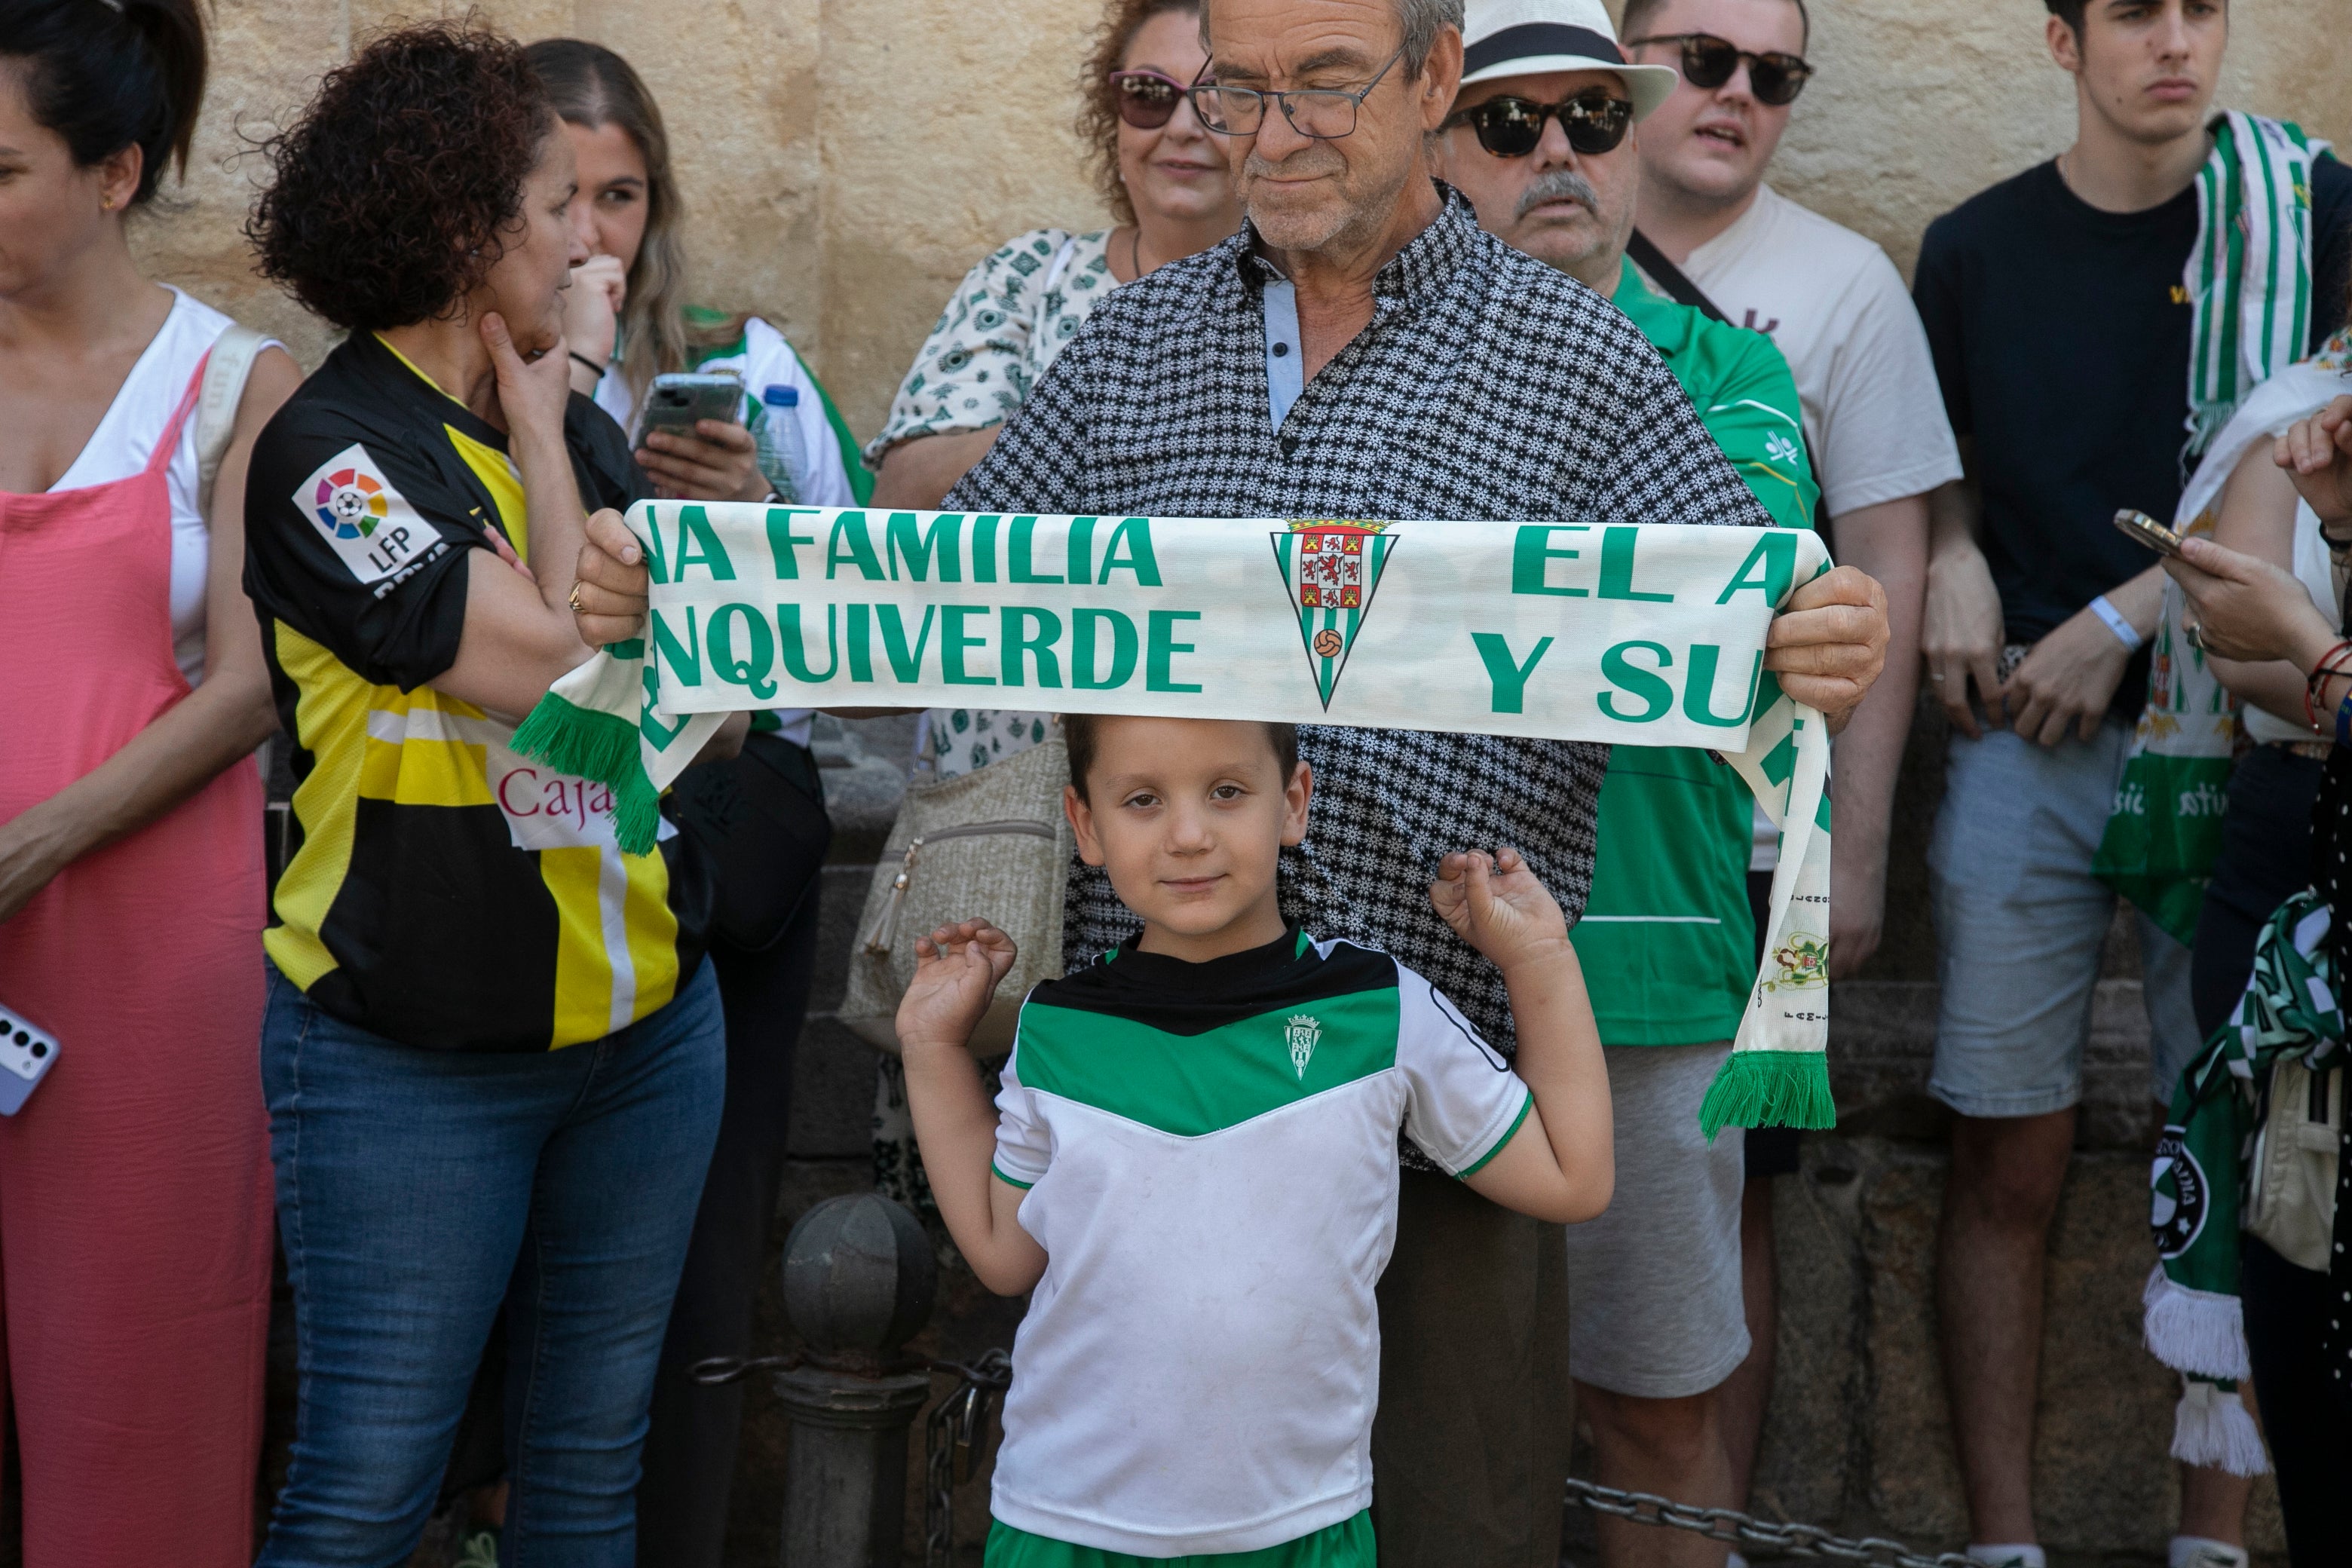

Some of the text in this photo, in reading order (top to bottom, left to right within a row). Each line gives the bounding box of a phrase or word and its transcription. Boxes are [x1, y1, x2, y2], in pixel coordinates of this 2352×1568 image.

[368, 527, 409, 573] LFP
[766, 508, 1162, 586] FAMILIA
[1511, 525, 1674, 603] EL
[1471, 632, 1764, 727] Y SU
